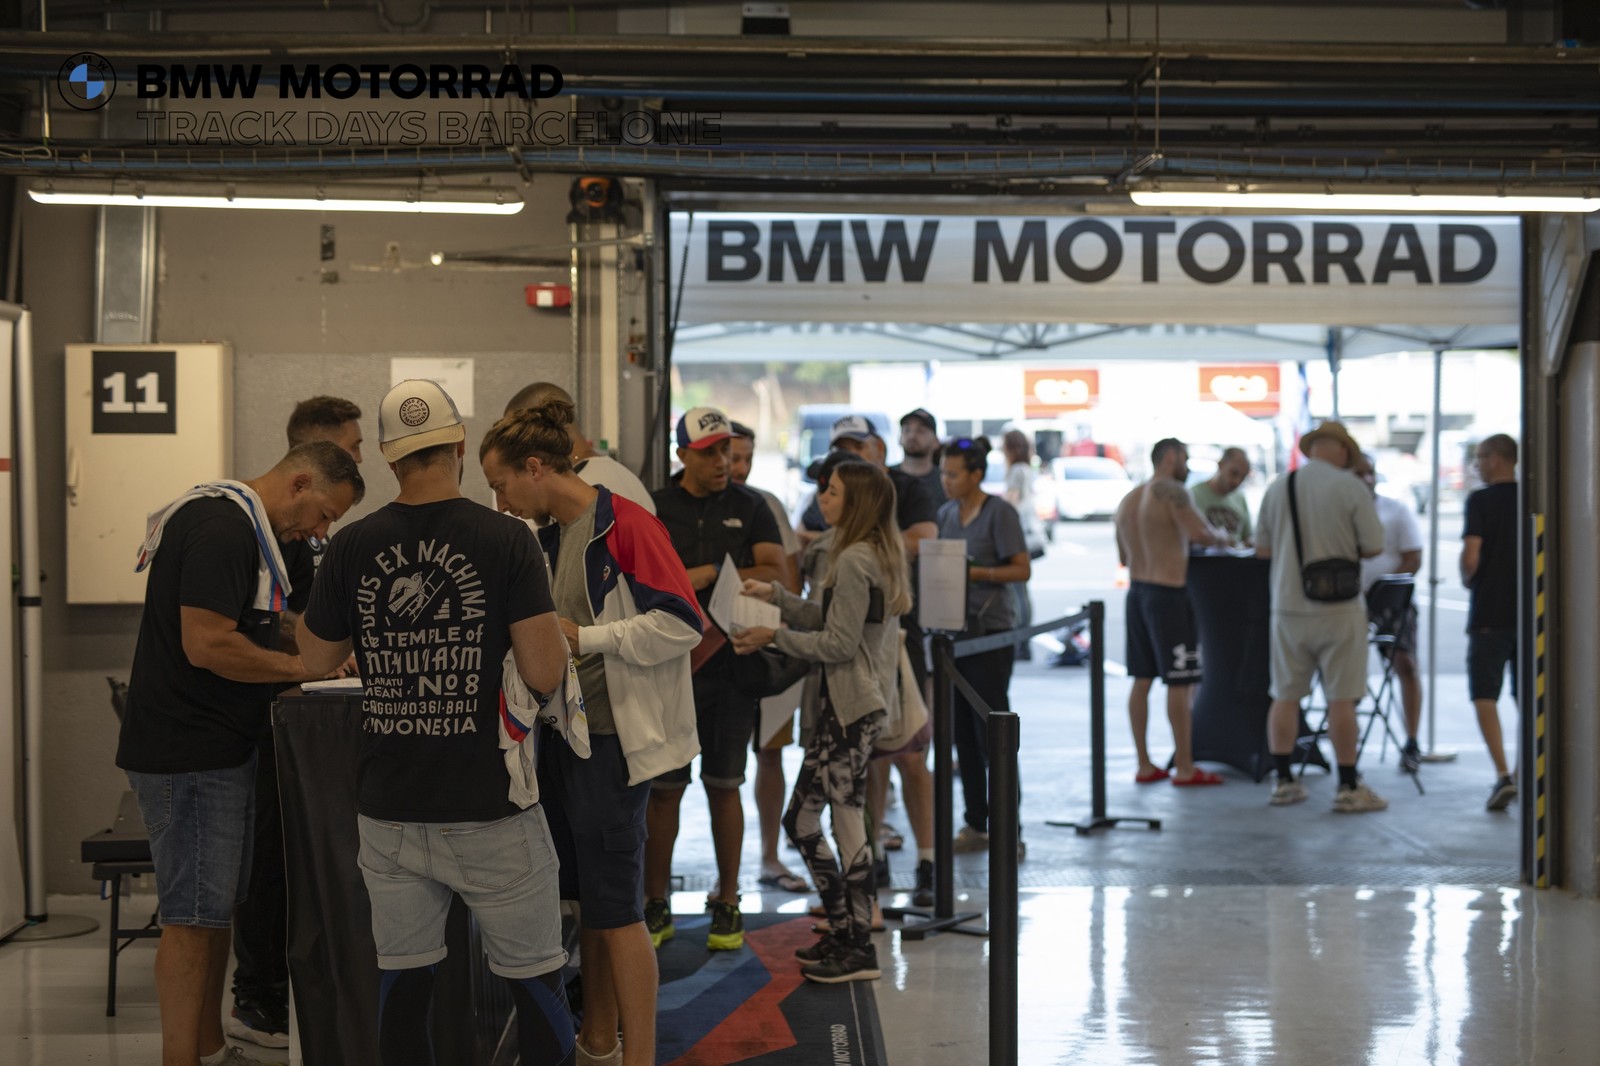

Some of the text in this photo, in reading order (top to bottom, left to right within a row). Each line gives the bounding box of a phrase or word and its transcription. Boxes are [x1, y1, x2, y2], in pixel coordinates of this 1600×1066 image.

[706, 217, 1498, 285] BMW MOTORRAD
[102, 371, 168, 414] 11
[374, 543, 410, 576] EX
[383, 626, 461, 648] TEMPLE
[465, 623, 484, 644] of
[464, 673, 480, 696] 8
